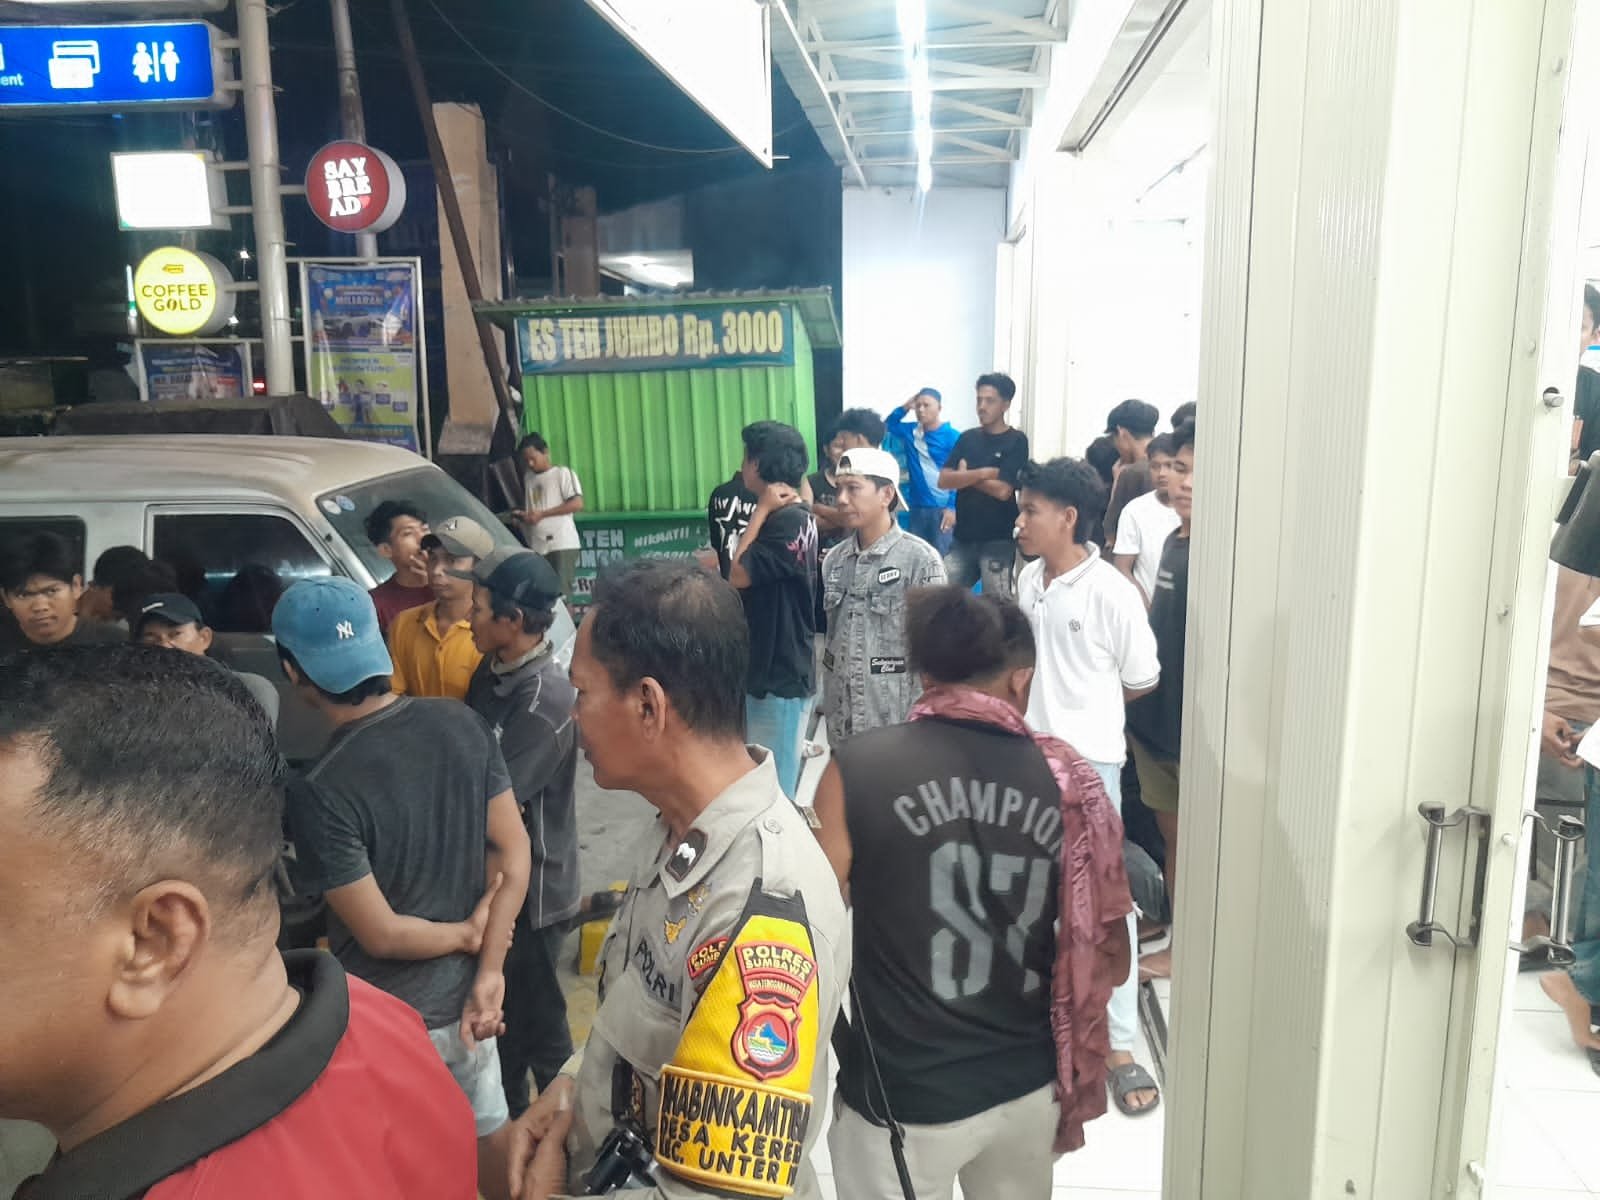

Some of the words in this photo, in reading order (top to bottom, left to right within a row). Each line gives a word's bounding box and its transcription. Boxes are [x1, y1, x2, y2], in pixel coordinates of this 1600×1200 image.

[323, 156, 367, 180] SAY
[329, 196, 362, 217] AD
[141, 283, 209, 298] COFFEE
[153, 297, 202, 312] GOLD
[528, 317, 558, 362] ES
[558, 317, 601, 361] TEH
[604, 312, 680, 359] JUMBO
[682, 312, 720, 360] Rp.
[722, 309, 784, 355] 3000
[582, 528, 625, 549] TEH
[893, 776, 1065, 855] CHAMPIO
[929, 840, 1052, 1002] 87
[742, 945, 813, 975] POLRES
[745, 958, 807, 983] SUMBAWA
[659, 1114, 710, 1148] DESA
[698, 1146, 781, 1185] UNTER
